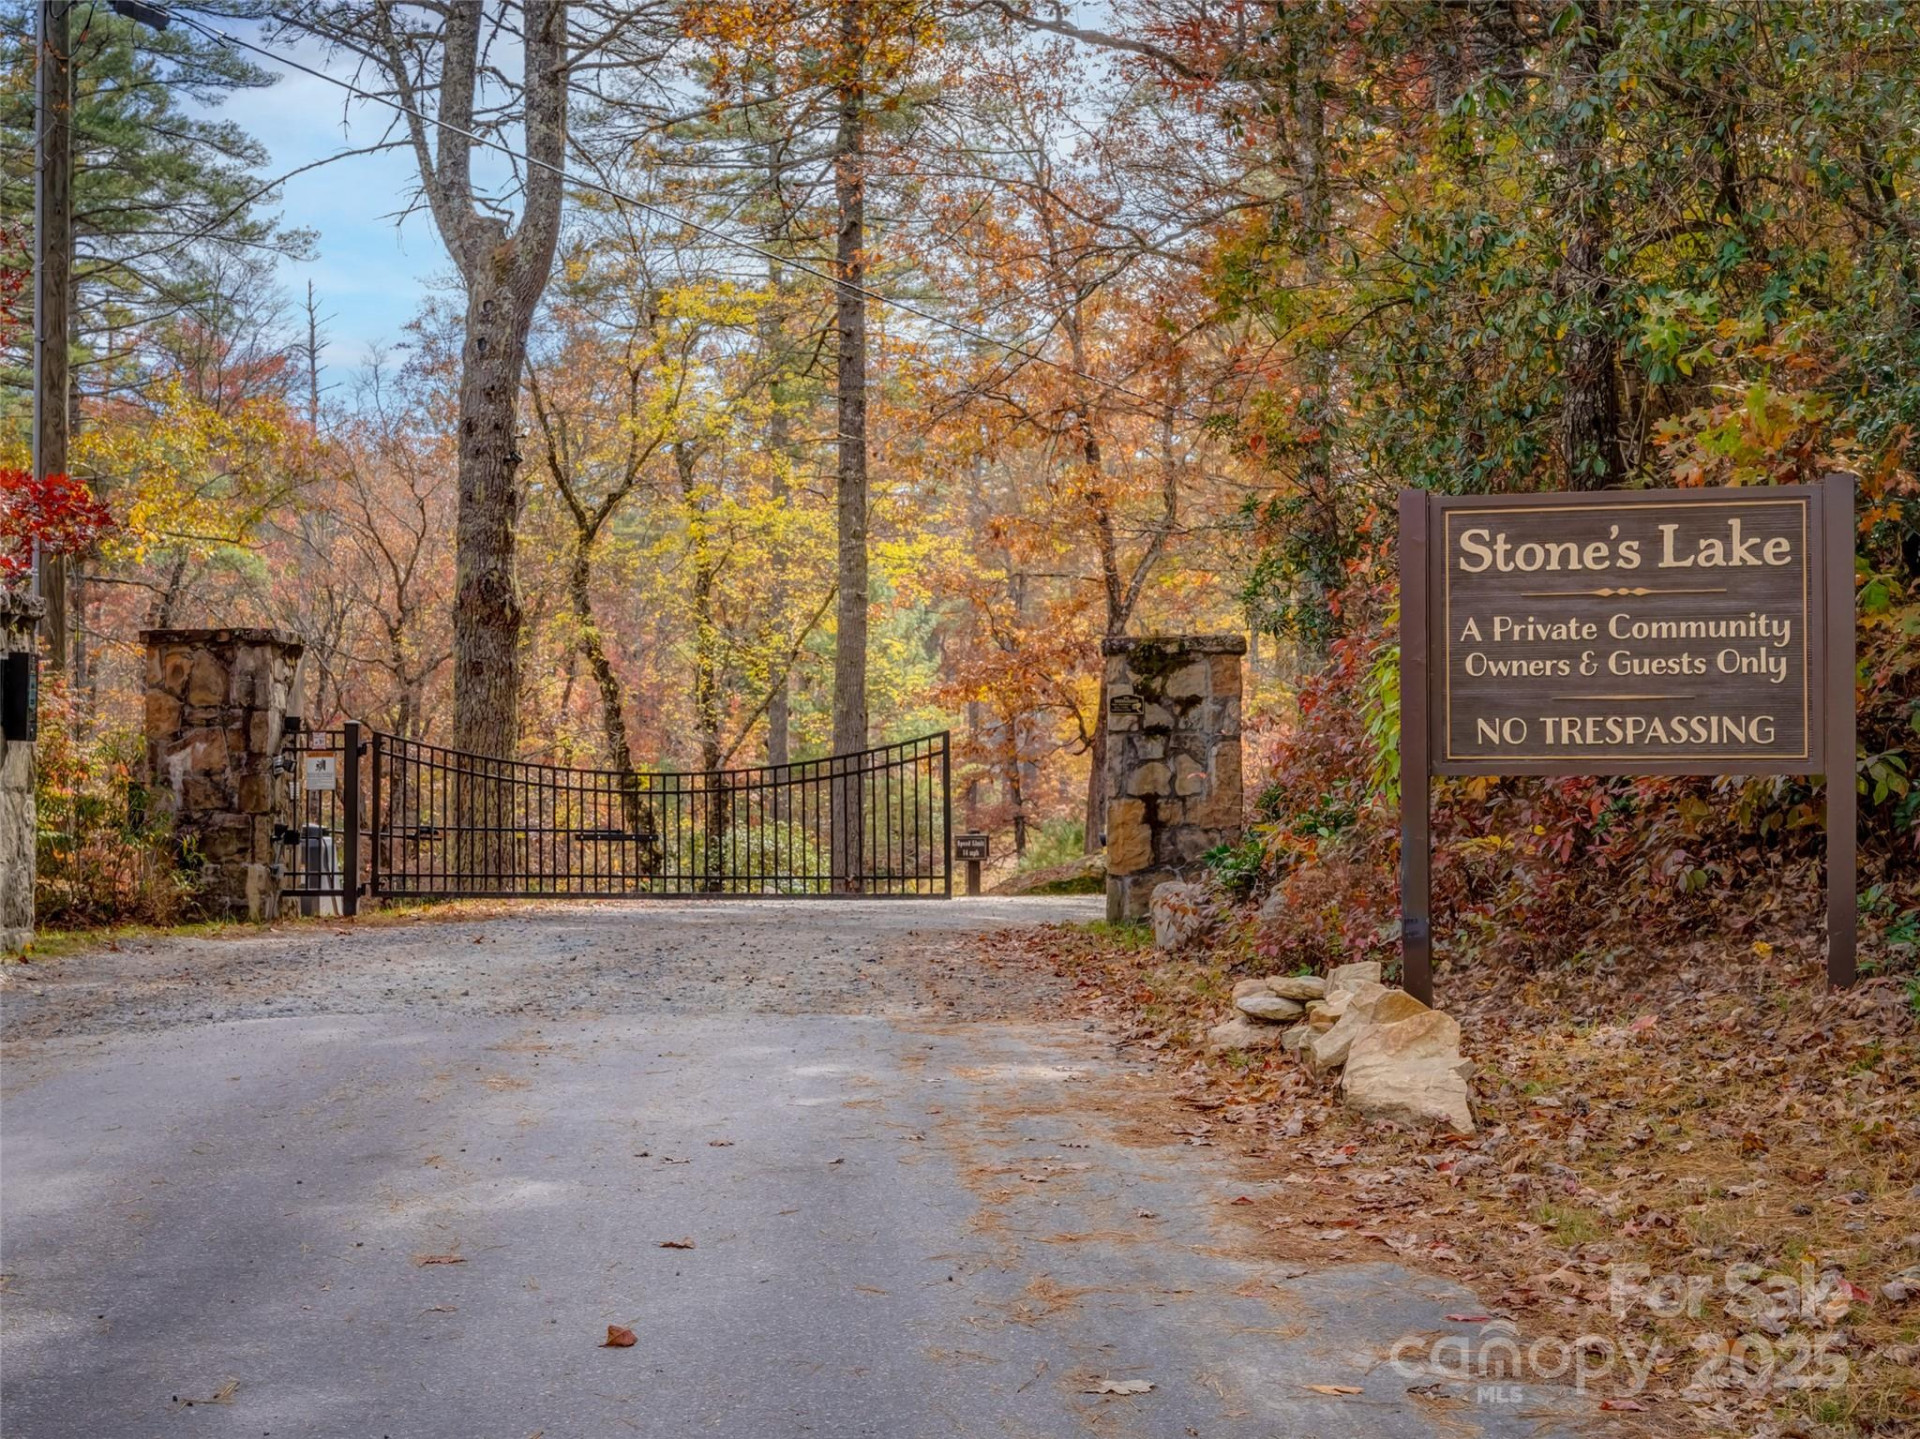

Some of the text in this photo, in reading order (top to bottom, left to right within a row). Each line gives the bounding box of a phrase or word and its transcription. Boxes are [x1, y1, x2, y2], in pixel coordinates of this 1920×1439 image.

[1459, 518, 1792, 573] Stone's Lake
[1460, 612, 1792, 648] A Private Community
[1465, 646, 1788, 684] Owners & Guests Only
[1477, 715, 1775, 745] NO TRESPASSING
